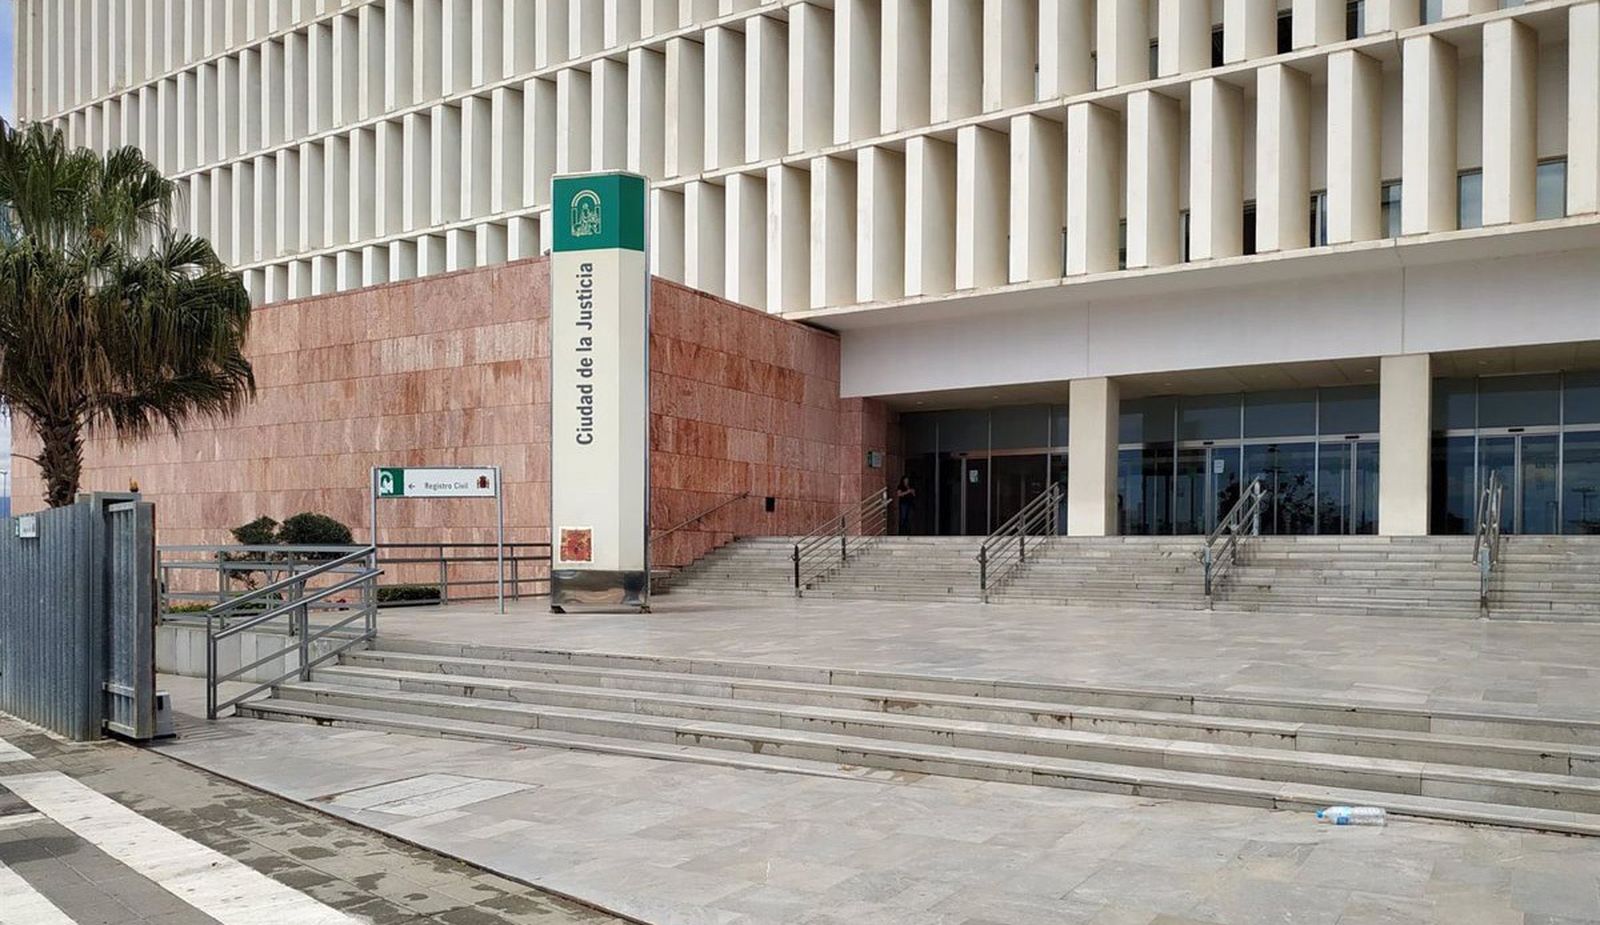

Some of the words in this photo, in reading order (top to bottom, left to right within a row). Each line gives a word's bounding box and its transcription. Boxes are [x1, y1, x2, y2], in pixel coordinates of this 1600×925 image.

[576, 263, 593, 330] Justicia
[576, 336, 593, 352] la
[576, 357, 593, 378] de
[576, 384, 594, 445] Ciudad
[424, 482, 452, 491] Registro
[453, 481, 469, 490] Civil
